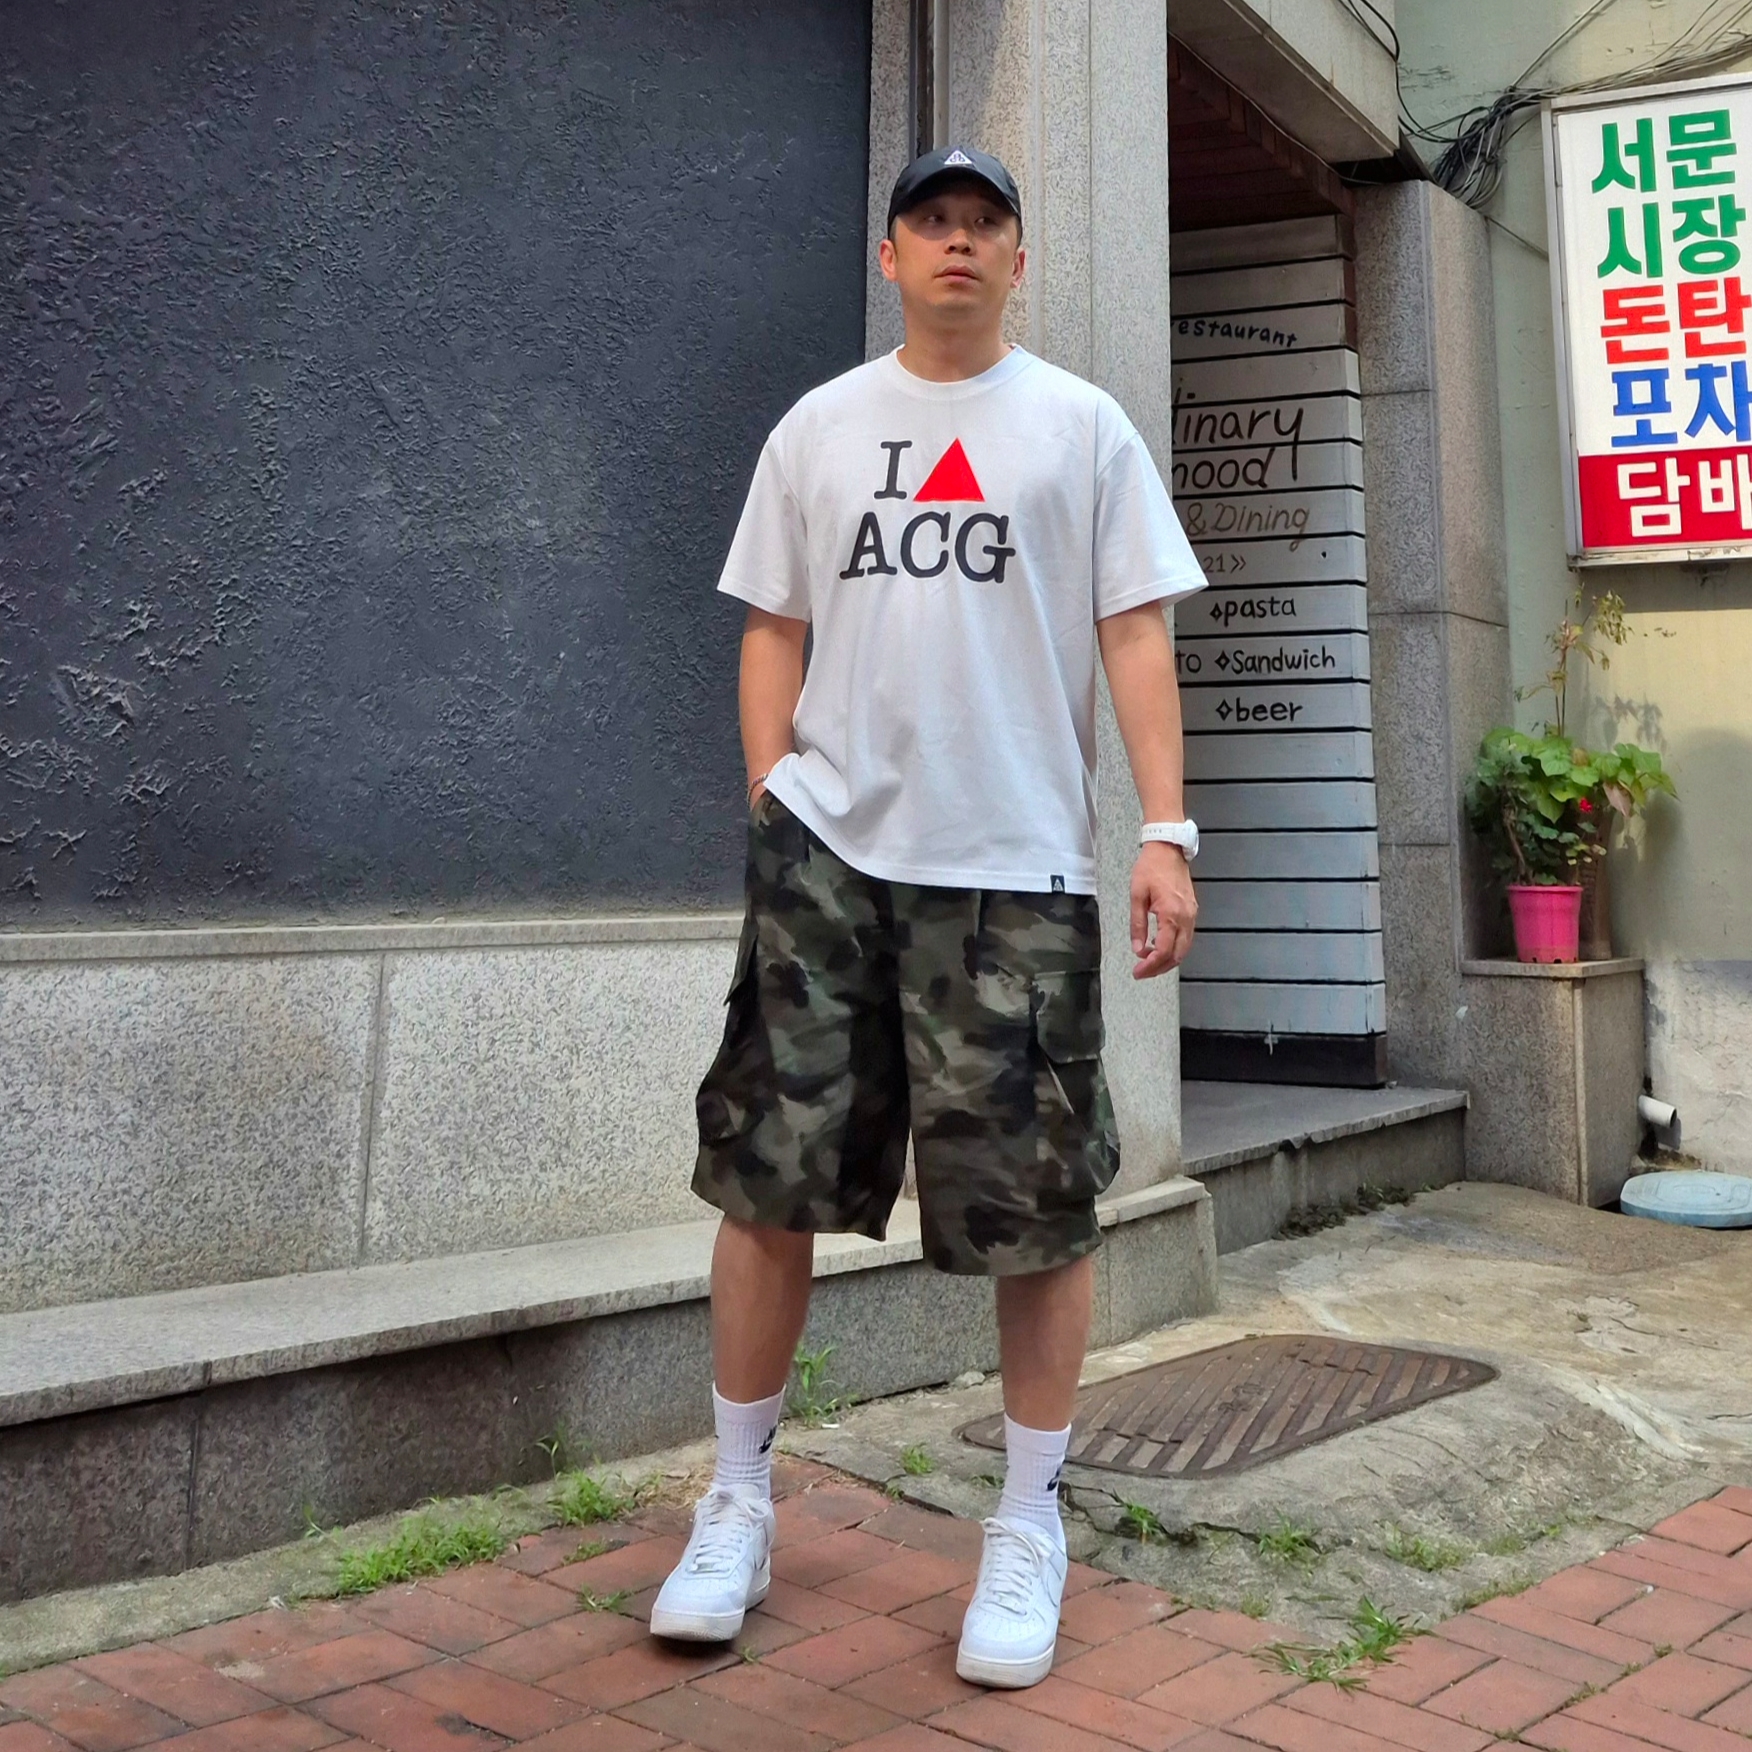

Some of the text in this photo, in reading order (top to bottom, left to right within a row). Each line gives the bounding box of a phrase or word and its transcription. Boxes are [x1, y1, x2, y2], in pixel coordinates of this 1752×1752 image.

[1591, 108, 1737, 194] 서문
[1597, 193, 1747, 279] 시장
[1171, 319, 1297, 347] estaurant
[1600, 276, 1752, 364] 돈탄
[873, 440, 913, 500] I
[839, 511, 1016, 584] ACG
[1213, 502, 1311, 552] Dining
[1231, 646, 1336, 675] Sandwich
[1236, 698, 1303, 723] beer
